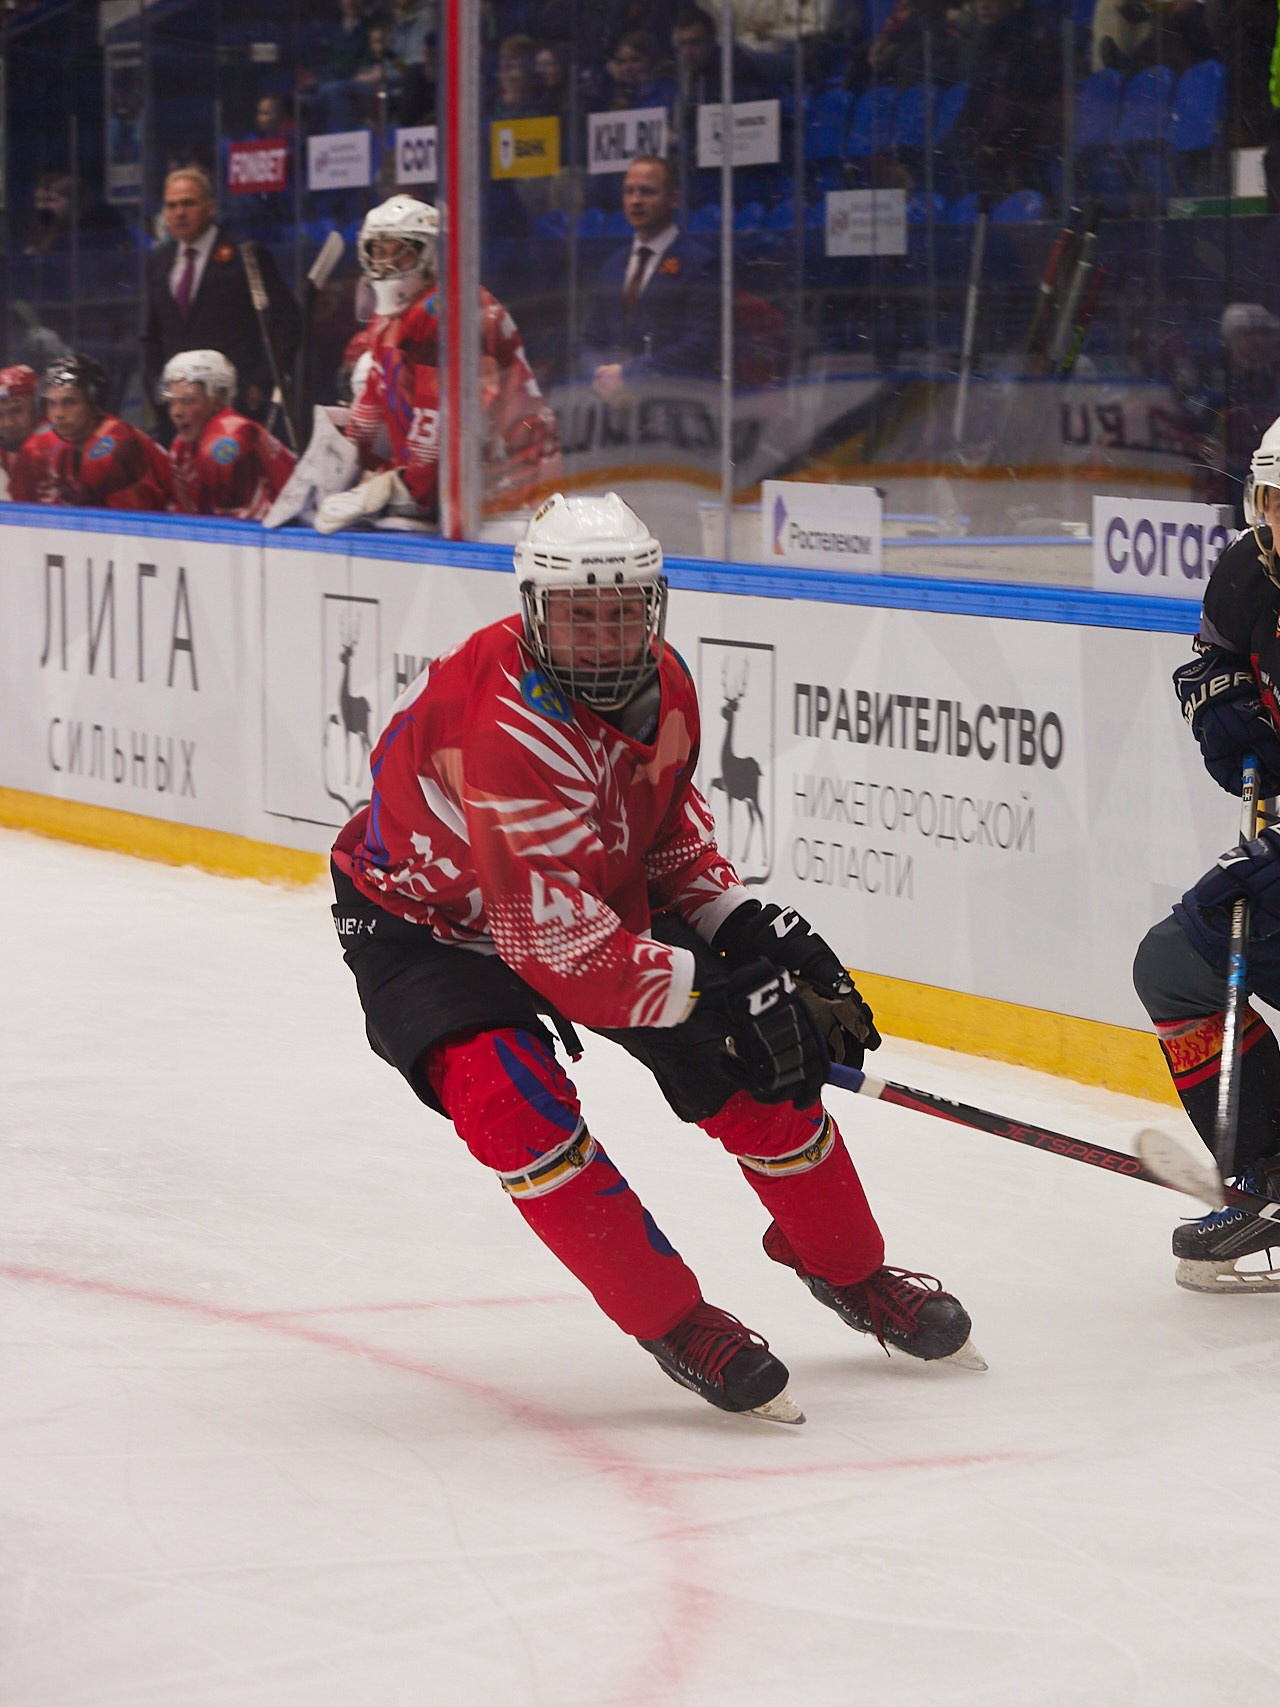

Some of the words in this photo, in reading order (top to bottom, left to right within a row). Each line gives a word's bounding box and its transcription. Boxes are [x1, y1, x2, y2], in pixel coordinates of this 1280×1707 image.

[593, 118, 665, 163] KHL.RU
[788, 521, 873, 556] Ростелеком
[39, 553, 198, 692] ЛИГА
[49, 716, 197, 799] СИЛЬНЫХ
[793, 682, 1063, 770] ПРАВИТЕЛЬСТВО
[792, 772, 1036, 853] НИЖЕГОРОДСКОЙ
[791, 836, 914, 900] ОБЛАСТИ
[991, 1122, 1141, 1177] JETSPEED
